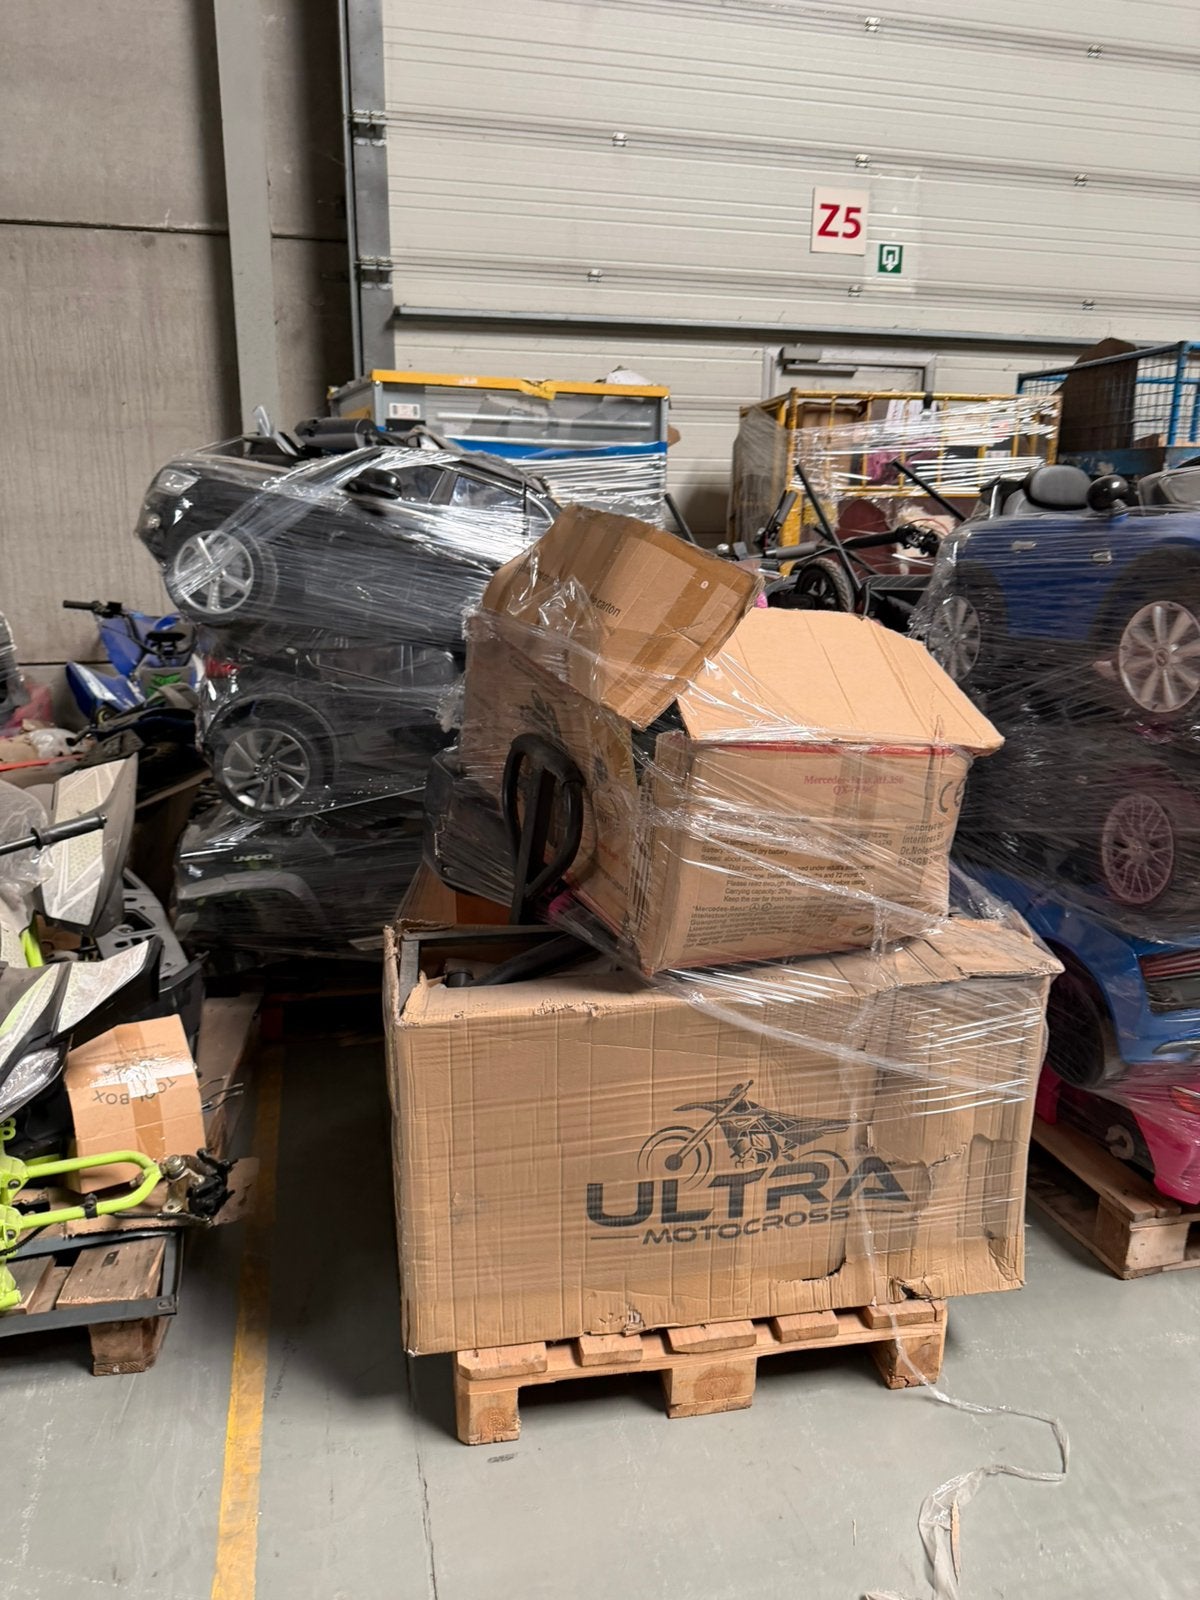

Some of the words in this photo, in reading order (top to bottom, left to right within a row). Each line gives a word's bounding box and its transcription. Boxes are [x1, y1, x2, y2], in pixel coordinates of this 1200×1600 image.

[817, 203, 862, 239] Z5
[596, 598, 621, 618] carton
[93, 1090, 130, 1105] BOX
[586, 1155, 912, 1228] ULTRA
[642, 1204, 850, 1245] MOTOCROSS
